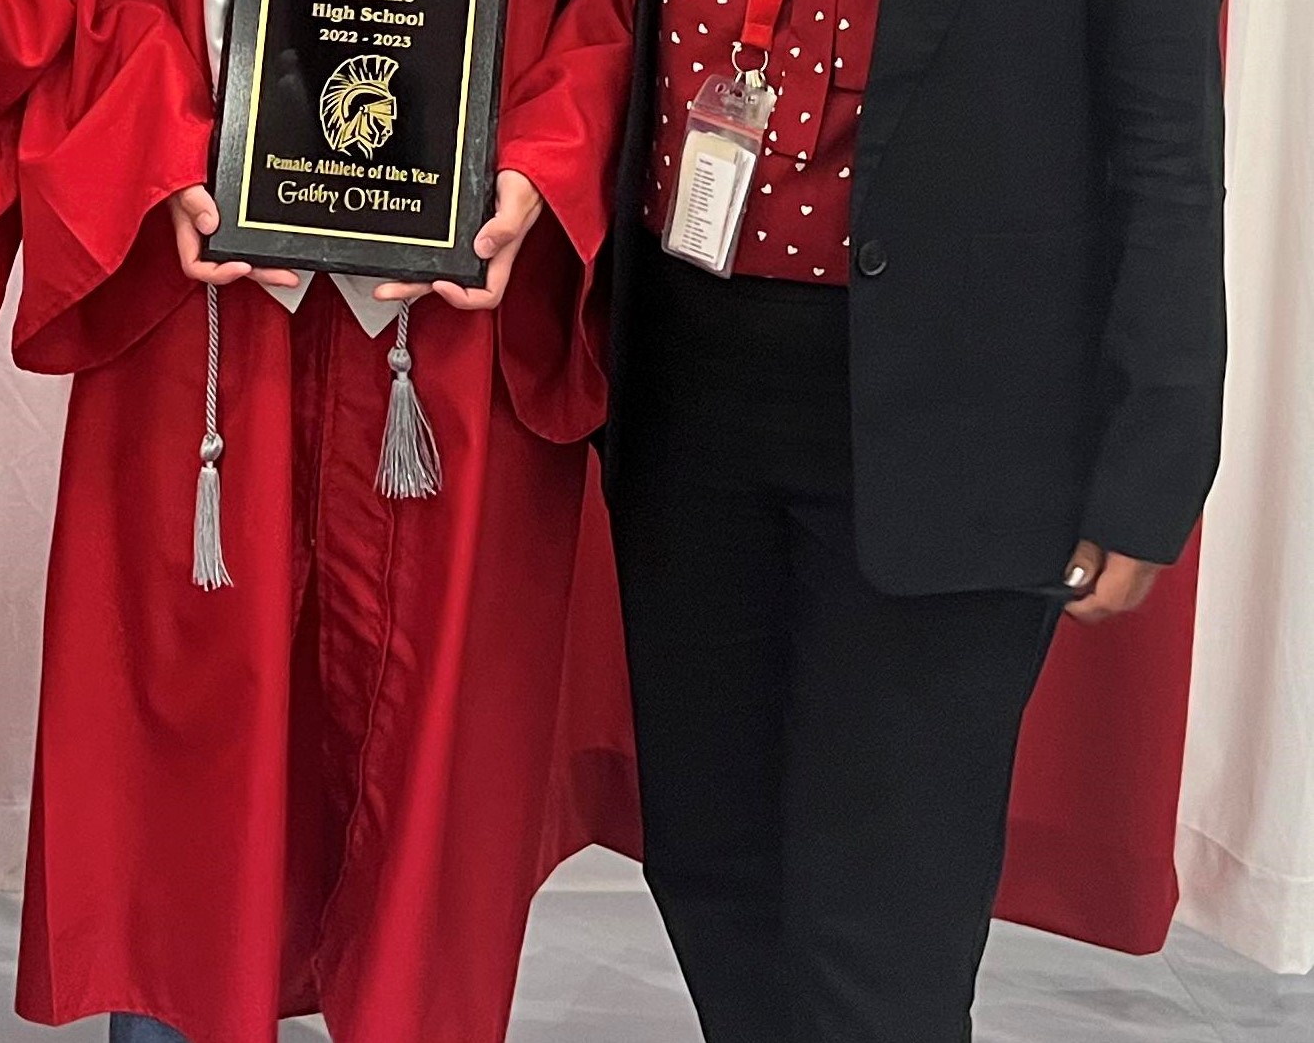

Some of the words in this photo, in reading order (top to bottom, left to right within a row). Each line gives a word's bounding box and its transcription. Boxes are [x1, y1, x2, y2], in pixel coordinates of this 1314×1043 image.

[312, 2, 355, 23] High
[360, 7, 425, 27] School
[319, 28, 358, 44] 2022
[373, 33, 412, 48] 2023
[266, 154, 313, 173] Female
[314, 159, 365, 178] Athlete
[367, 164, 384, 179] of
[386, 165, 408, 181] the
[411, 168, 440, 185] Year
[277, 180, 339, 213] Gabby
[343, 187, 422, 213] O'Hara
